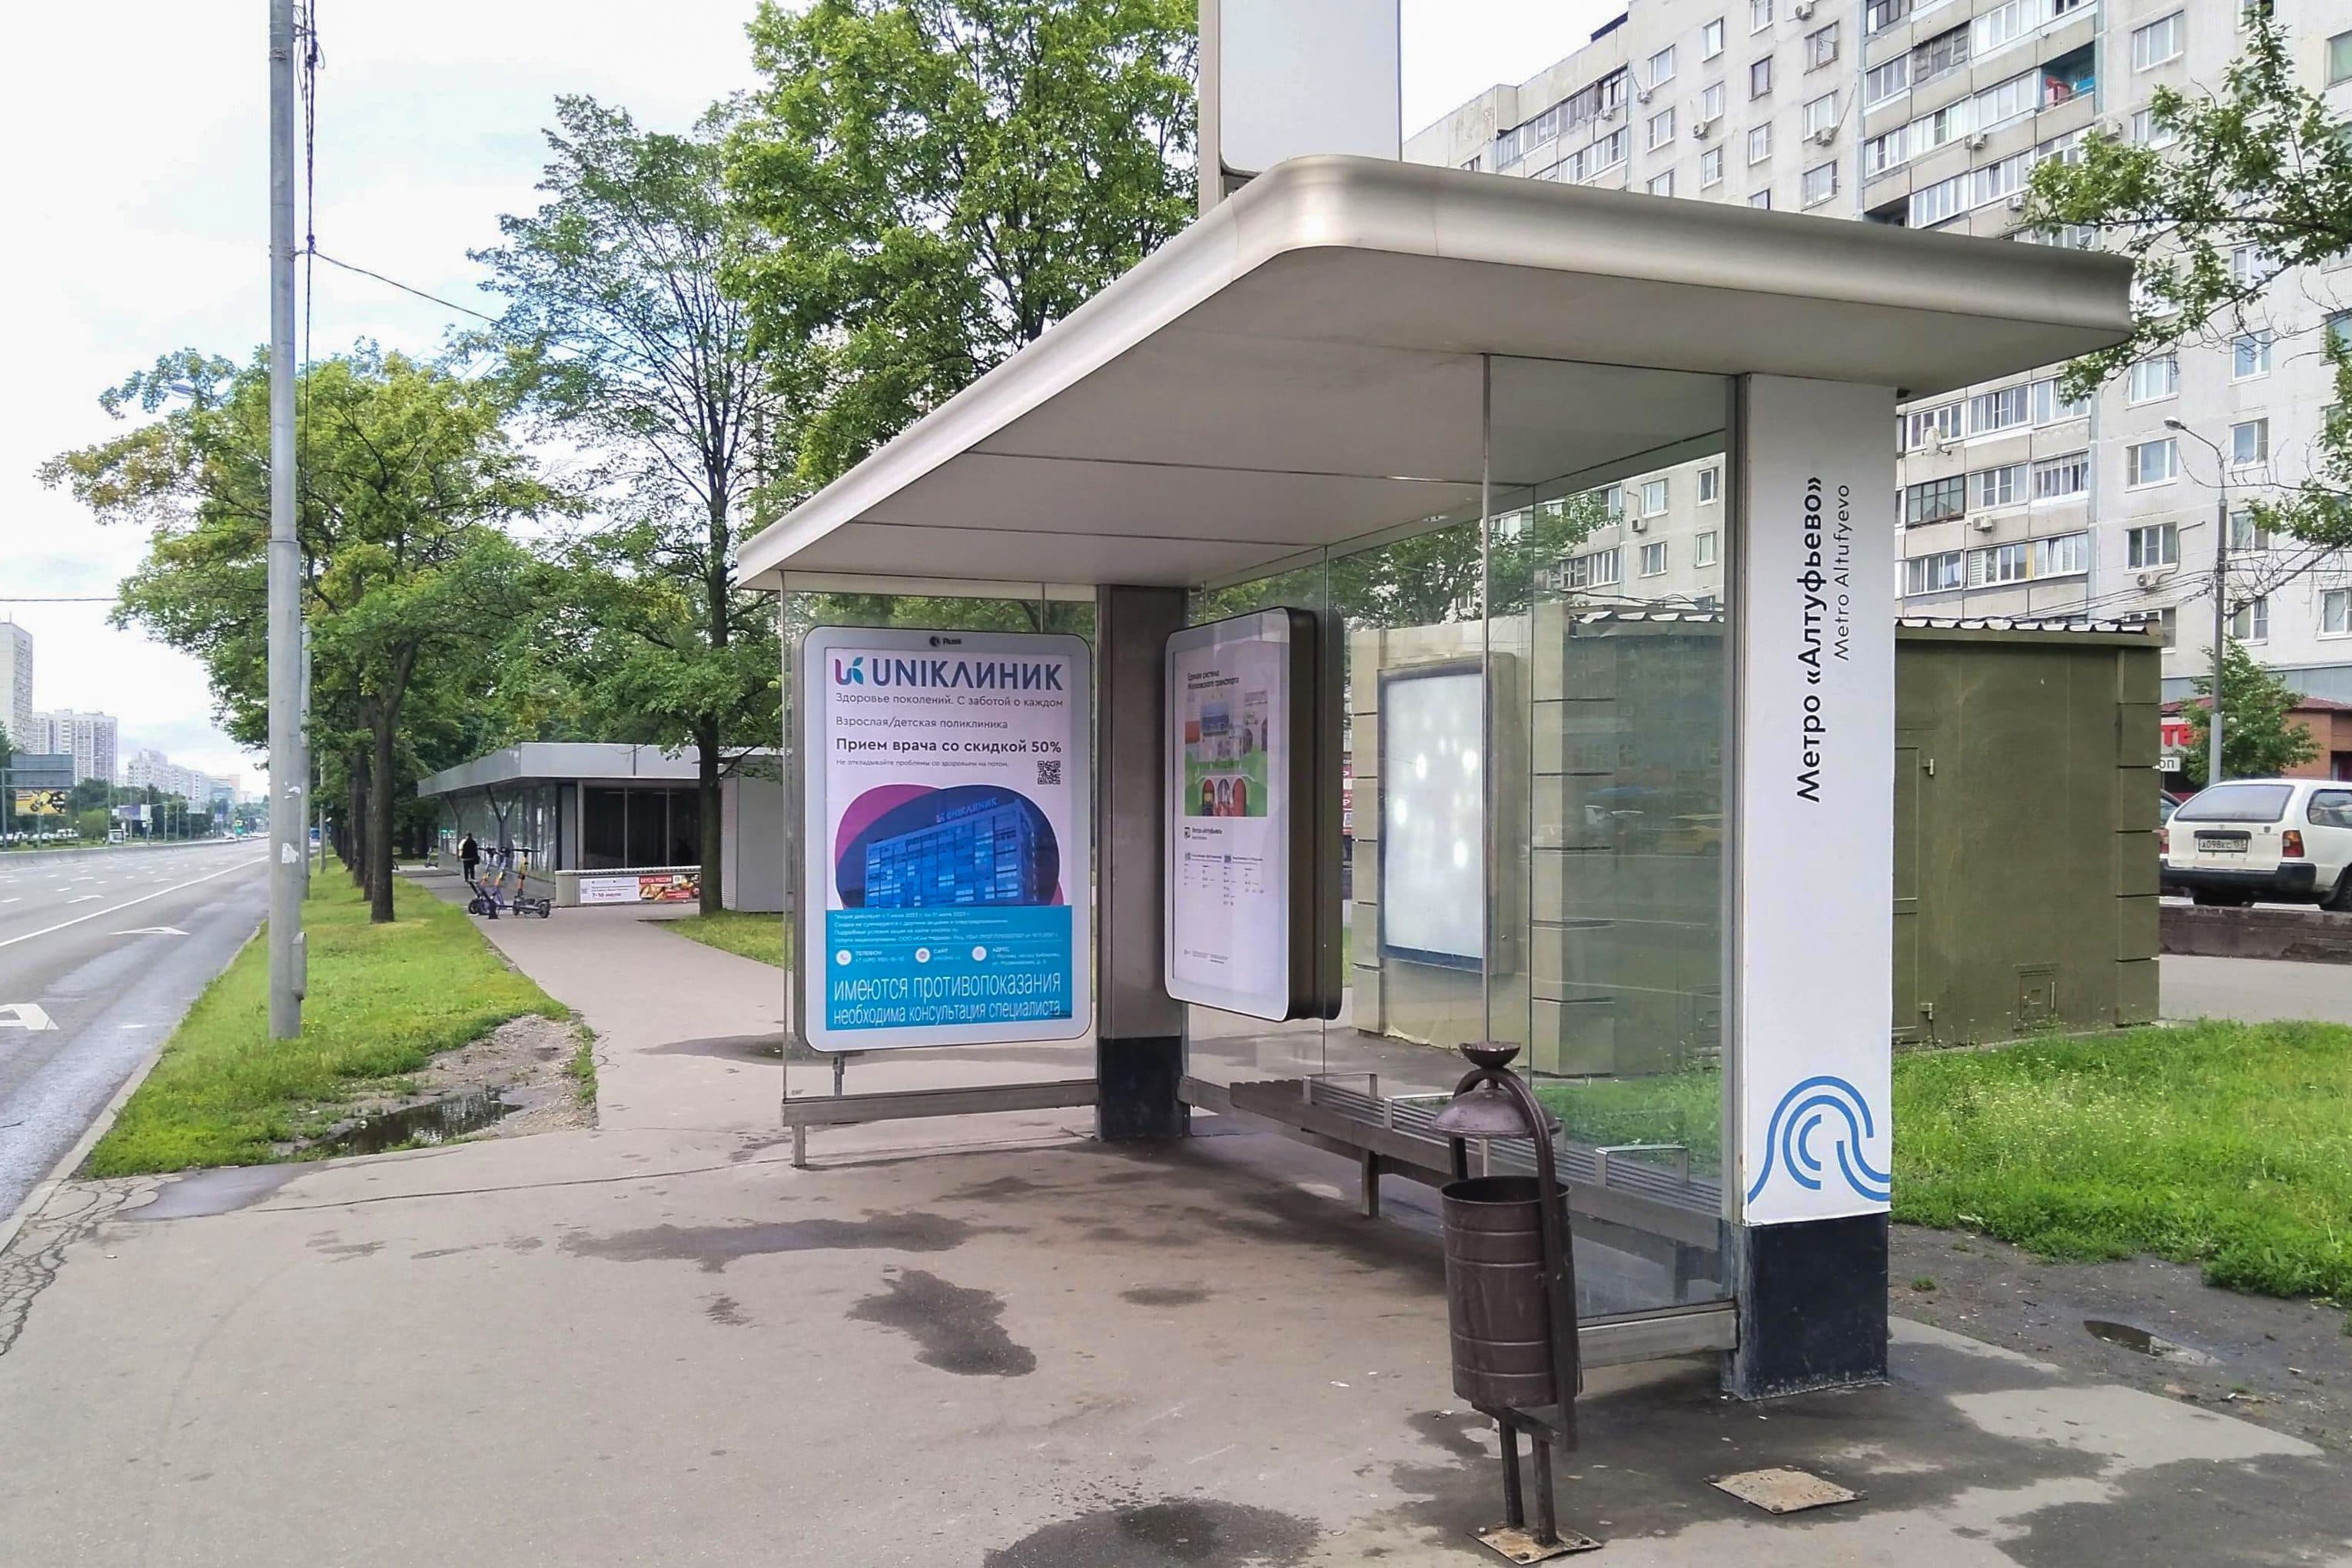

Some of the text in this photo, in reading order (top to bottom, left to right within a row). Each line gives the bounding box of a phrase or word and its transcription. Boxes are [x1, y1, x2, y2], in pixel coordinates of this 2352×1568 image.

[1833, 484, 1853, 661] Metro Altufyevo
[1797, 477, 1827, 802] Метро «Алтуфьево»
[836, 693, 889, 704] Здоровье
[893, 694, 953, 706] поколений.
[968, 696, 1010, 706] заботой
[1024, 698, 1063, 708] каждом
[836, 716, 1008, 729] Взрослая/детская поликлиника
[836, 739, 1061, 754] Прием врача со скидкой 50%
[834, 972, 1061, 1003] имеются противопоказания
[834, 999, 1060, 1025] необходима консультация специалиста
